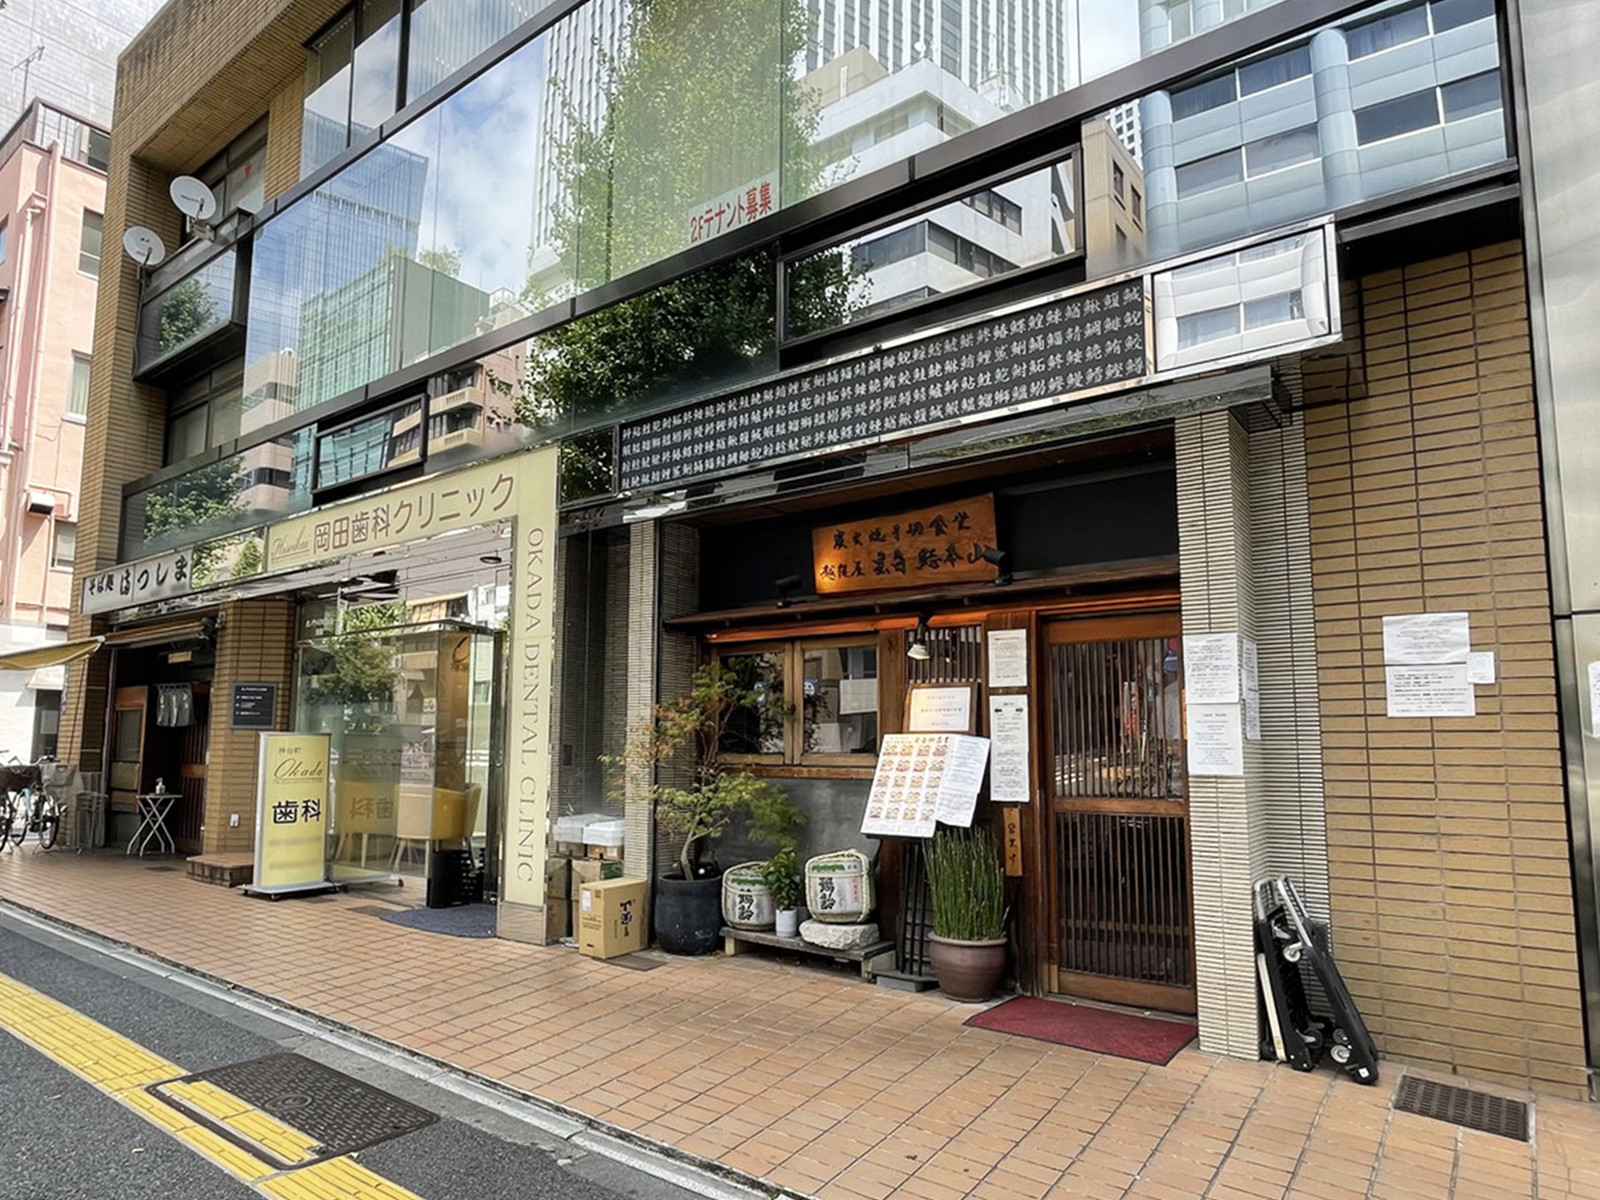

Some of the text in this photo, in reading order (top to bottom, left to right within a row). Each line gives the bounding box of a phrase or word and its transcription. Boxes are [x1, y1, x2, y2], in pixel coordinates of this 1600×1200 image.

[690, 181, 772, 243] 2Fテナント募集
[313, 473, 515, 555] 岡田歯科クリニック
[516, 527, 545, 882] OKADA DENTAL CLINIC
[272, 797, 322, 824] 歯科
